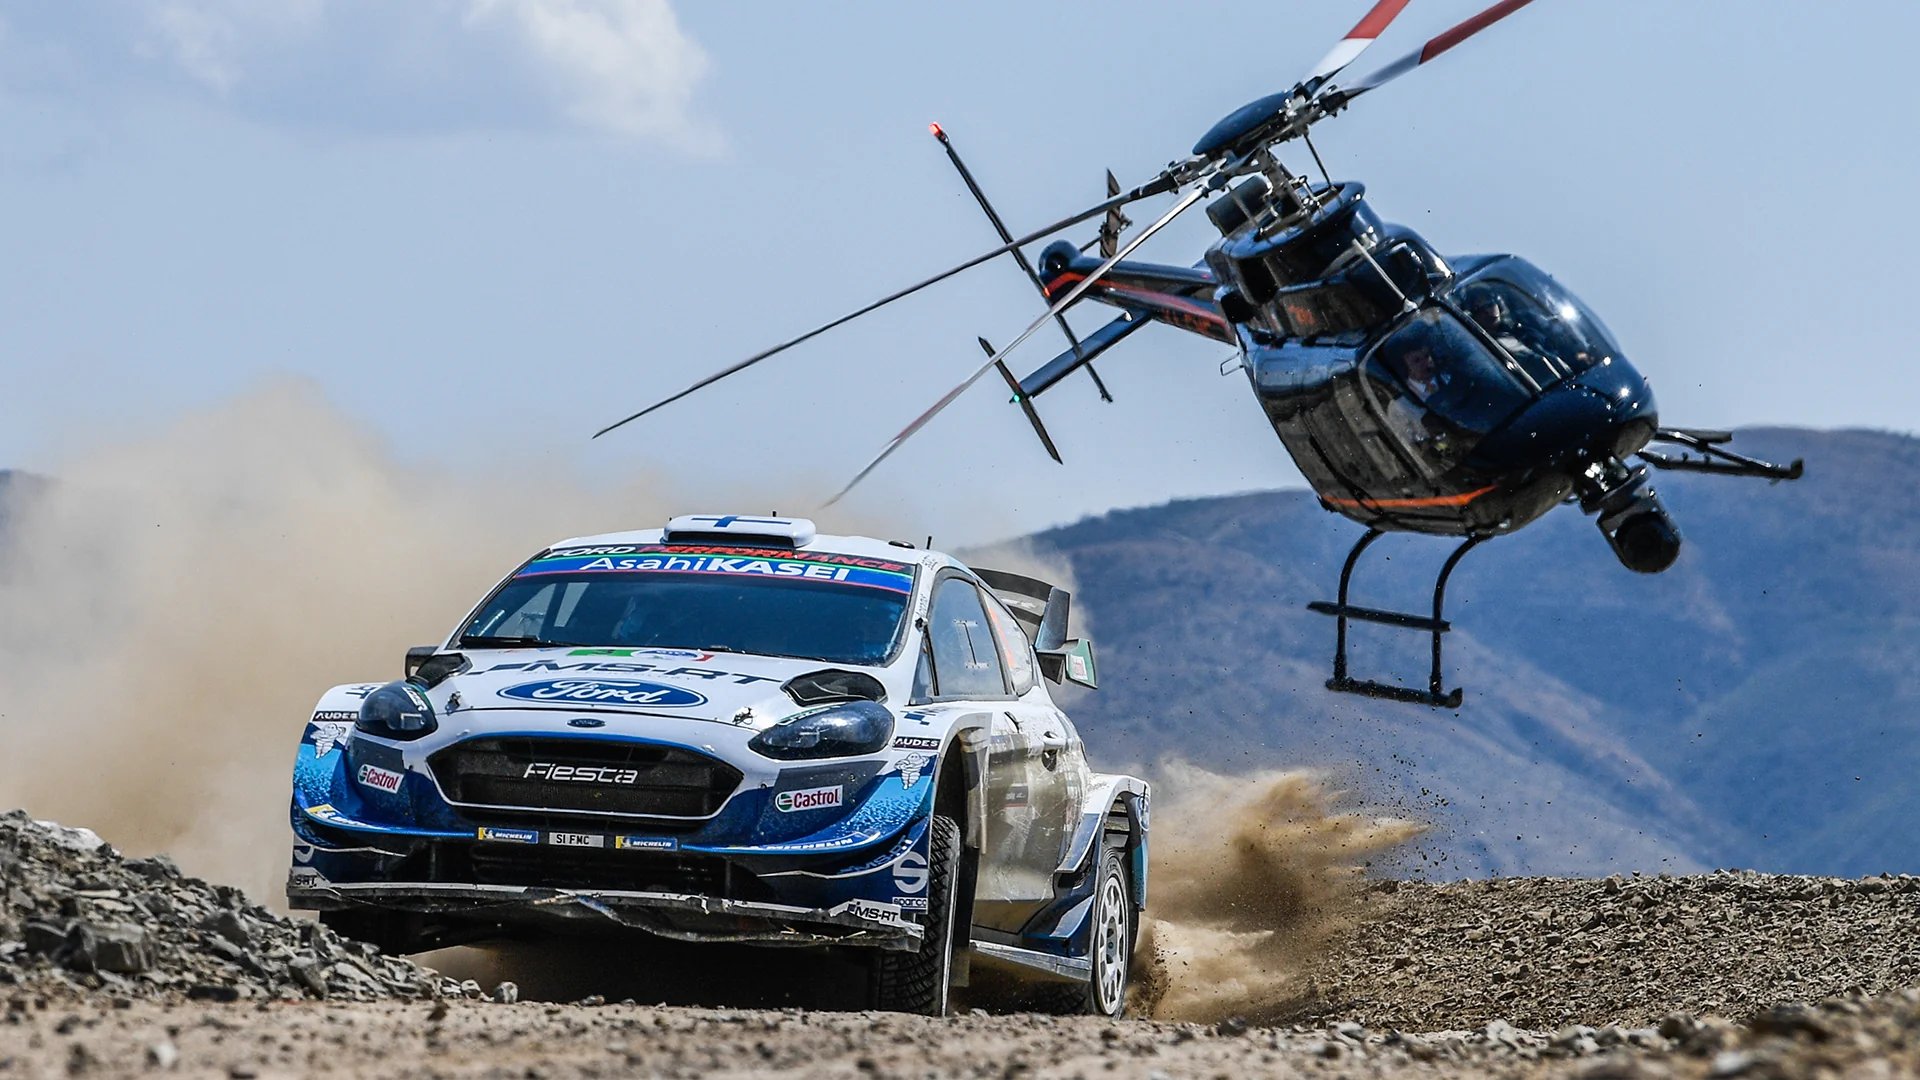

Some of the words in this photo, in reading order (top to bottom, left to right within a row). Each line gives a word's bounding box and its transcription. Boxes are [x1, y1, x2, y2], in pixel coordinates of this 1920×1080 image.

[543, 546, 636, 558] FORD
[637, 545, 905, 571] PERFORMANCE
[532, 680, 672, 703] Ford
[896, 737, 938, 747] AUDES
[366, 767, 399, 791] Castrol
[523, 763, 638, 784] Fiesta
[793, 788, 840, 808] Castrol
[494, 832, 533, 840] MICHELIN
[569, 835, 590, 845] FMC
[854, 905, 898, 921] MS-RT
